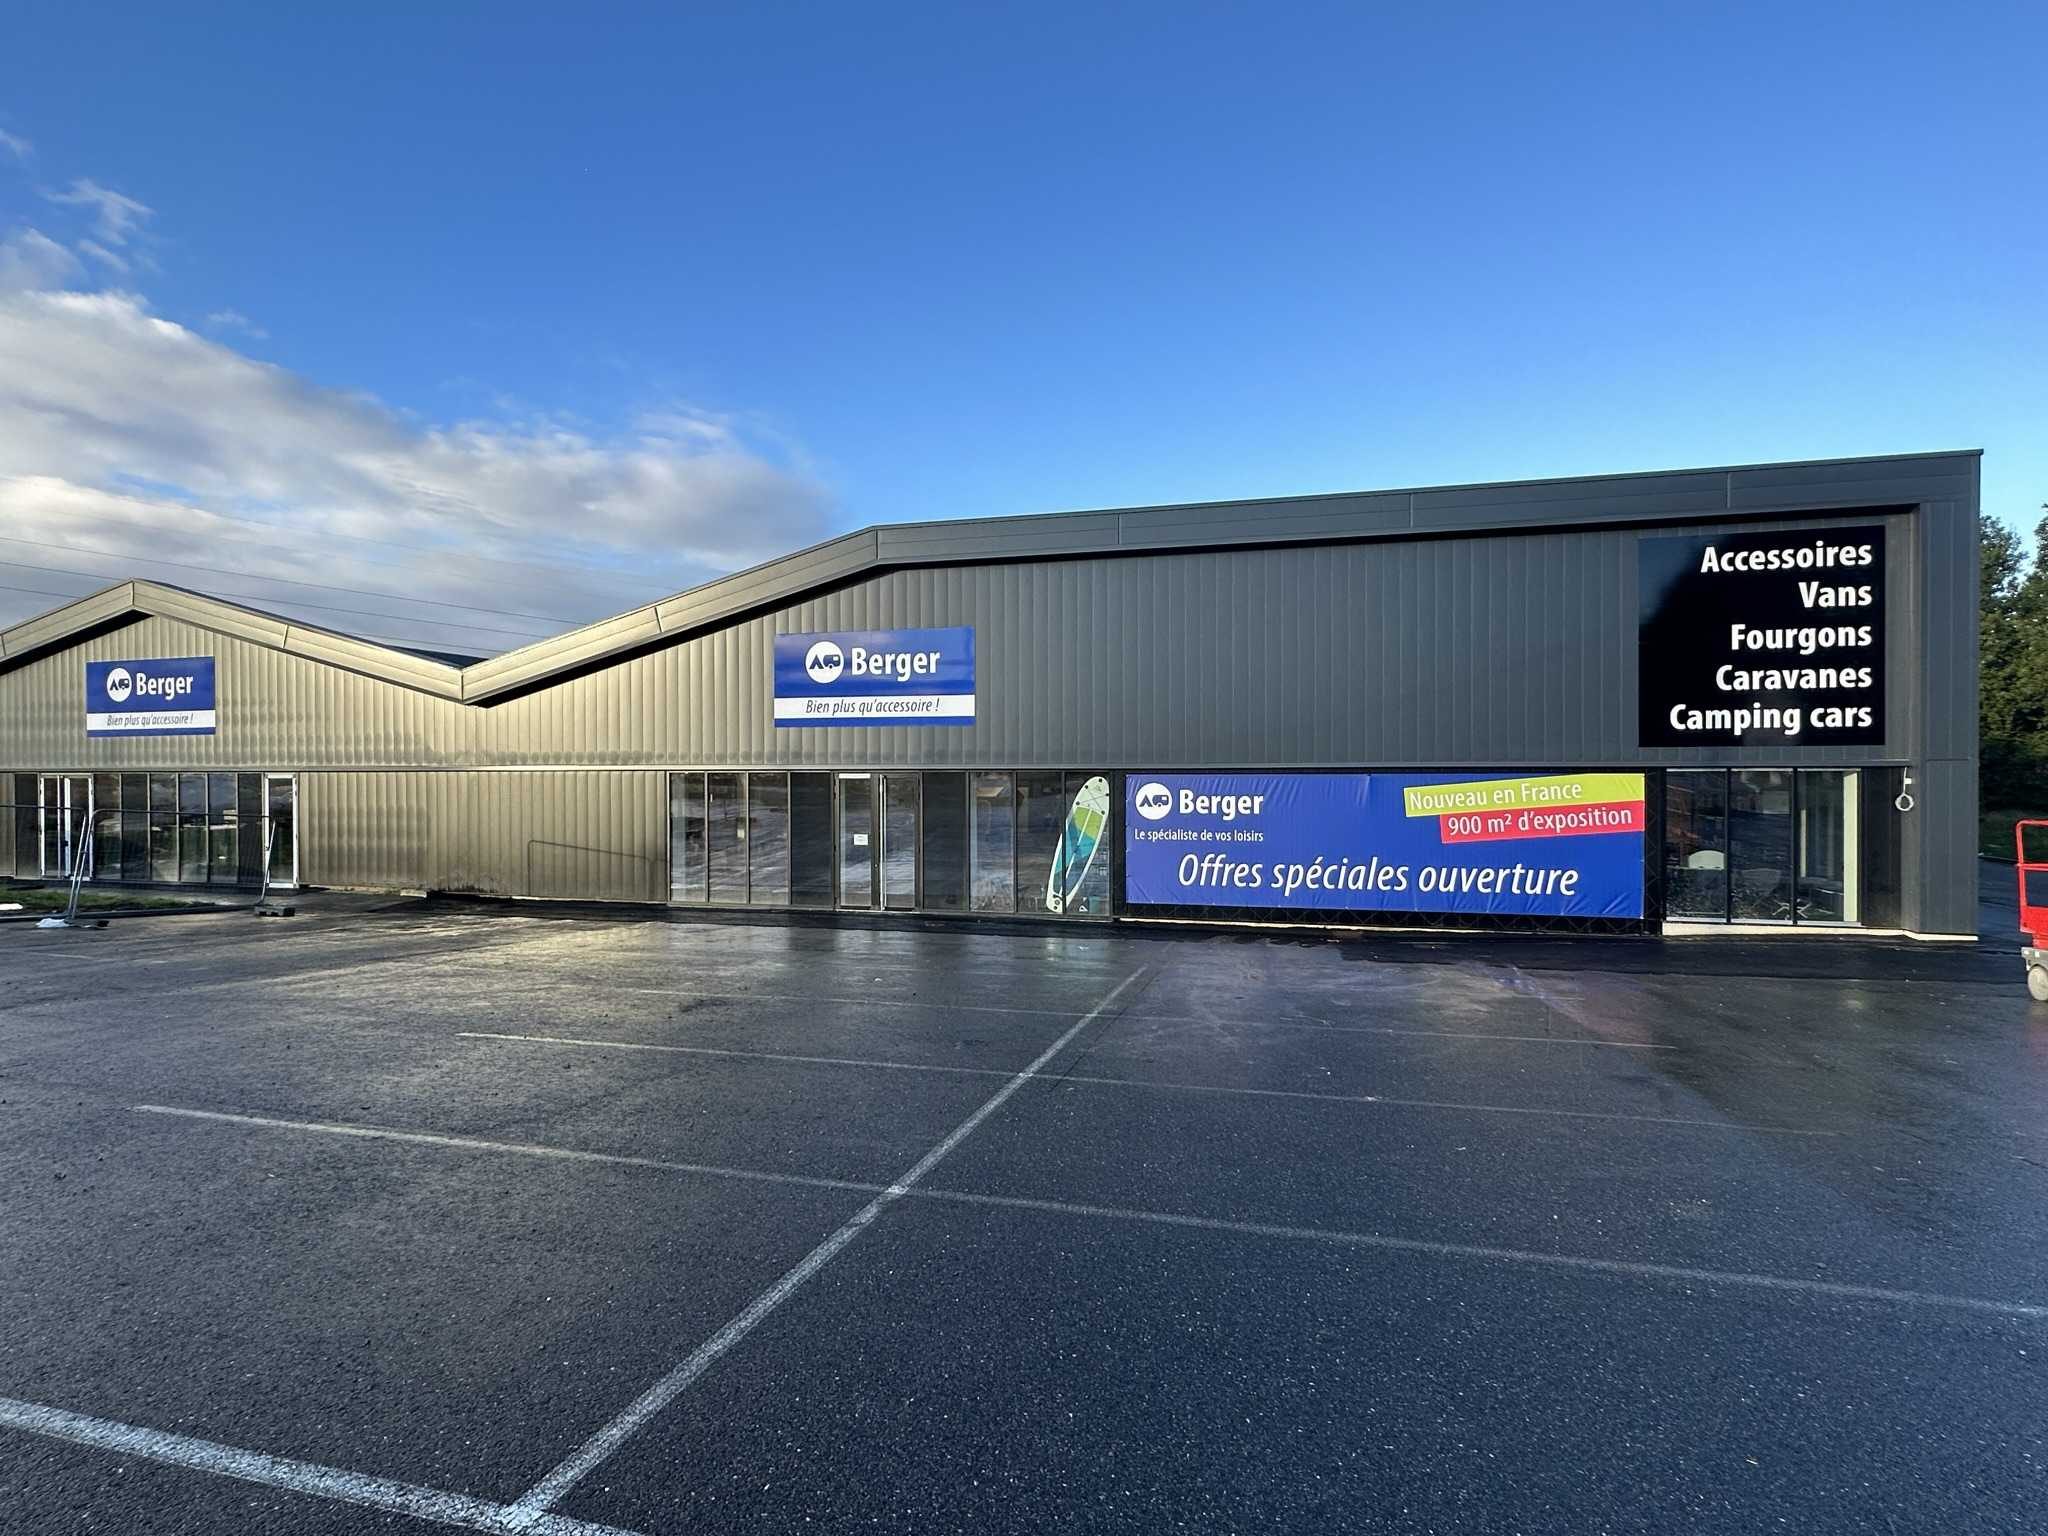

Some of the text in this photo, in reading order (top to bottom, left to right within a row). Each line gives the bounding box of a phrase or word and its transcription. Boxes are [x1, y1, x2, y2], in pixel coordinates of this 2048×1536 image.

[1700, 540, 1873, 573] Accessoires
[1798, 581, 1873, 608] Vans
[1731, 623, 1873, 655] Fourgons
[851, 647, 941, 682] Berger
[1715, 664, 1873, 691] Caravanes
[136, 672, 194, 701] Berger
[107, 714, 123, 727] Bien
[124, 714, 139, 728] plus
[805, 699, 830, 713] Bien
[832, 699, 856, 716] plus
[1669, 702, 1873, 736] Camping cars
[1179, 789, 1264, 821] Berger
[1408, 783, 1582, 811] Nouveau en France
[1134, 828, 1264, 842] Le spécialiste de vos loisirs
[1448, 815, 1483, 836] 900
[1178, 853, 1579, 897] Offres spéciales ouverture
